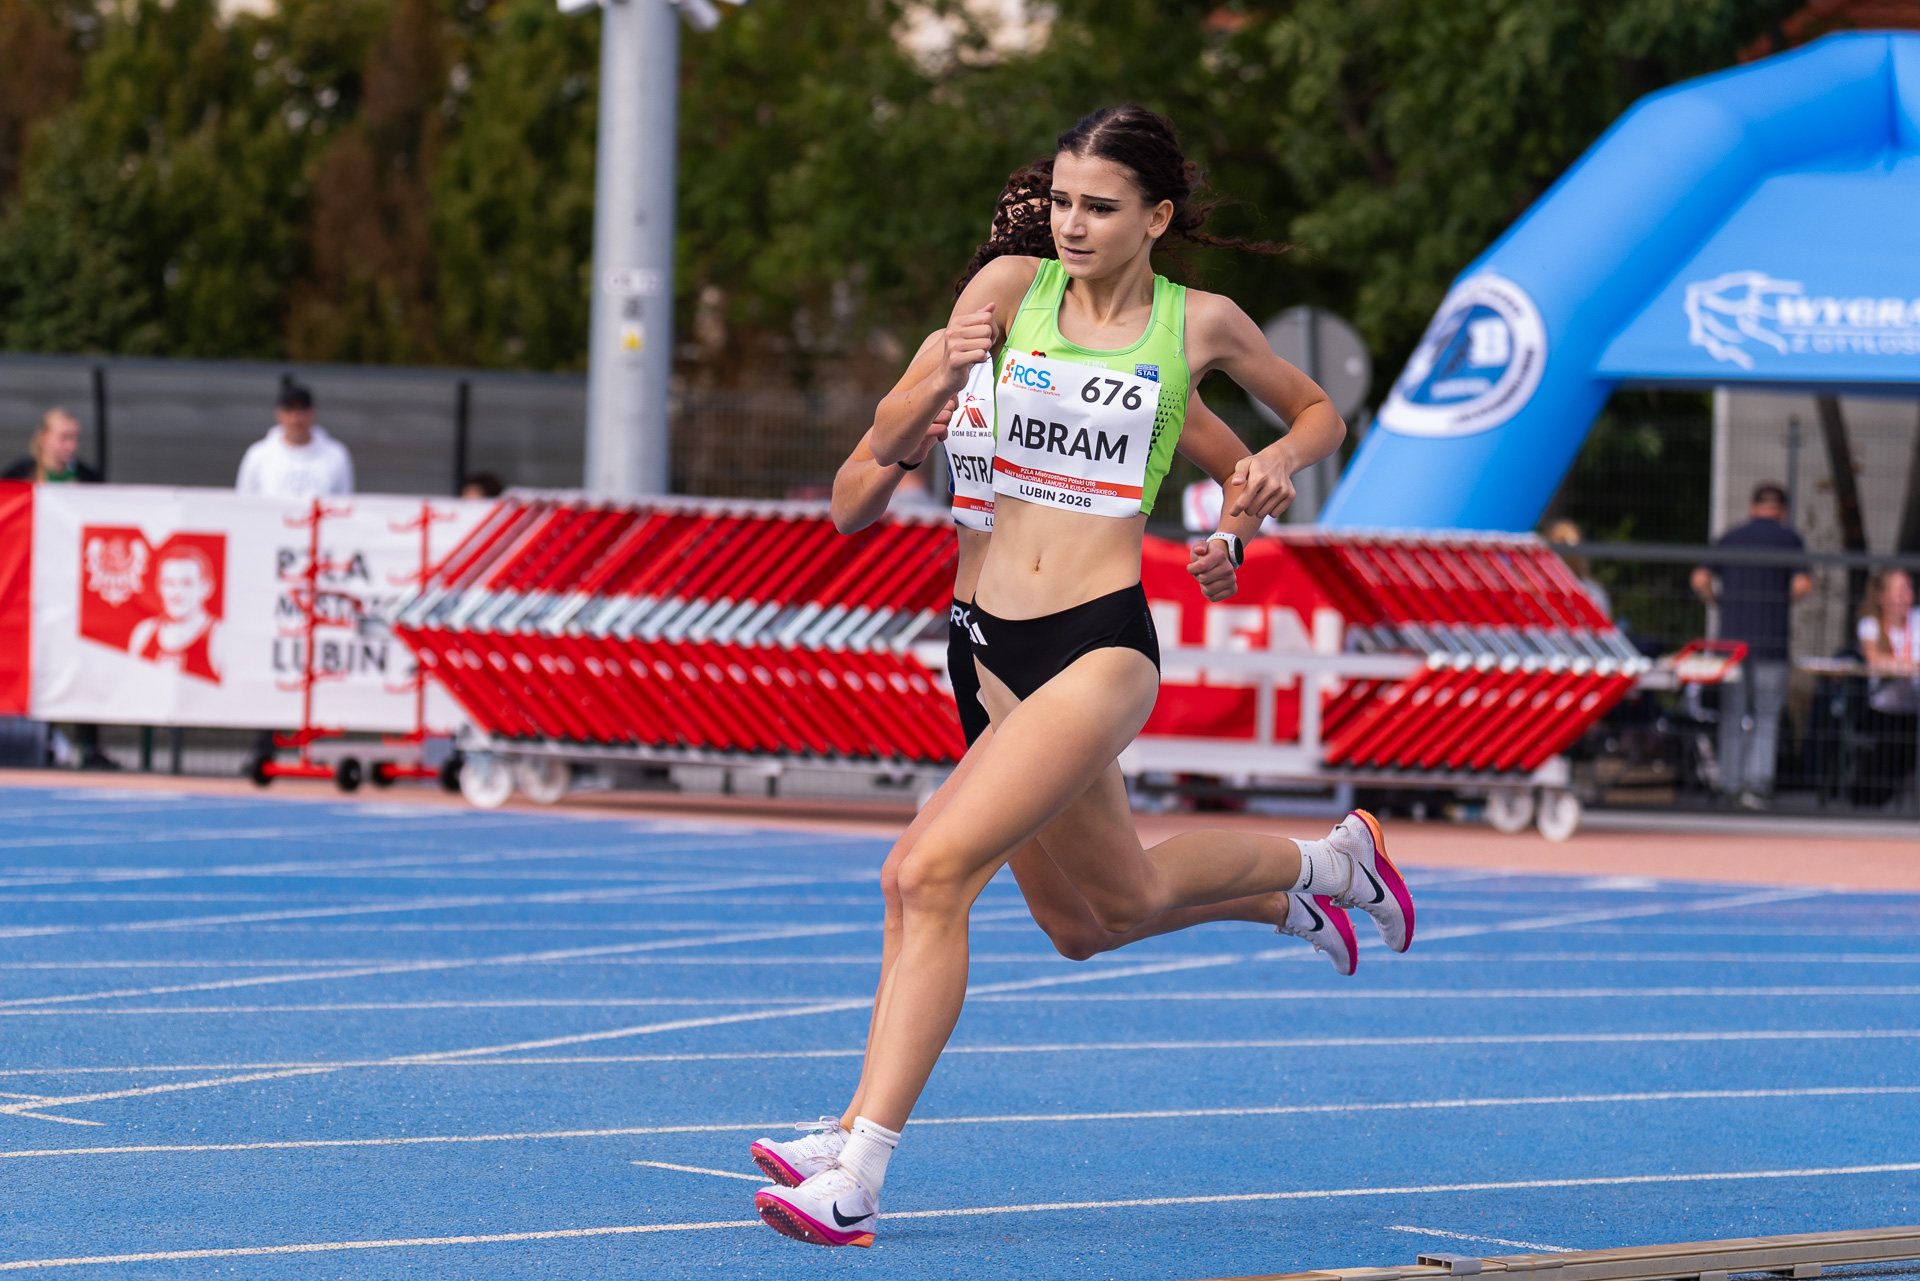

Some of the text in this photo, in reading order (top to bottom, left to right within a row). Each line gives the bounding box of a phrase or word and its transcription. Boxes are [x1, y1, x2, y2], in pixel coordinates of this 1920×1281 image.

[1081, 376, 1142, 411] 676
[1008, 414, 1129, 464] ABRAM
[1035, 469, 1068, 482] Mistrzostwa
[1068, 476, 1085, 486] Polski
[1085, 479, 1096, 487] U16
[1044, 478, 1070, 490] JANUSZA
[1020, 484, 1092, 508] LUBIN 2026
